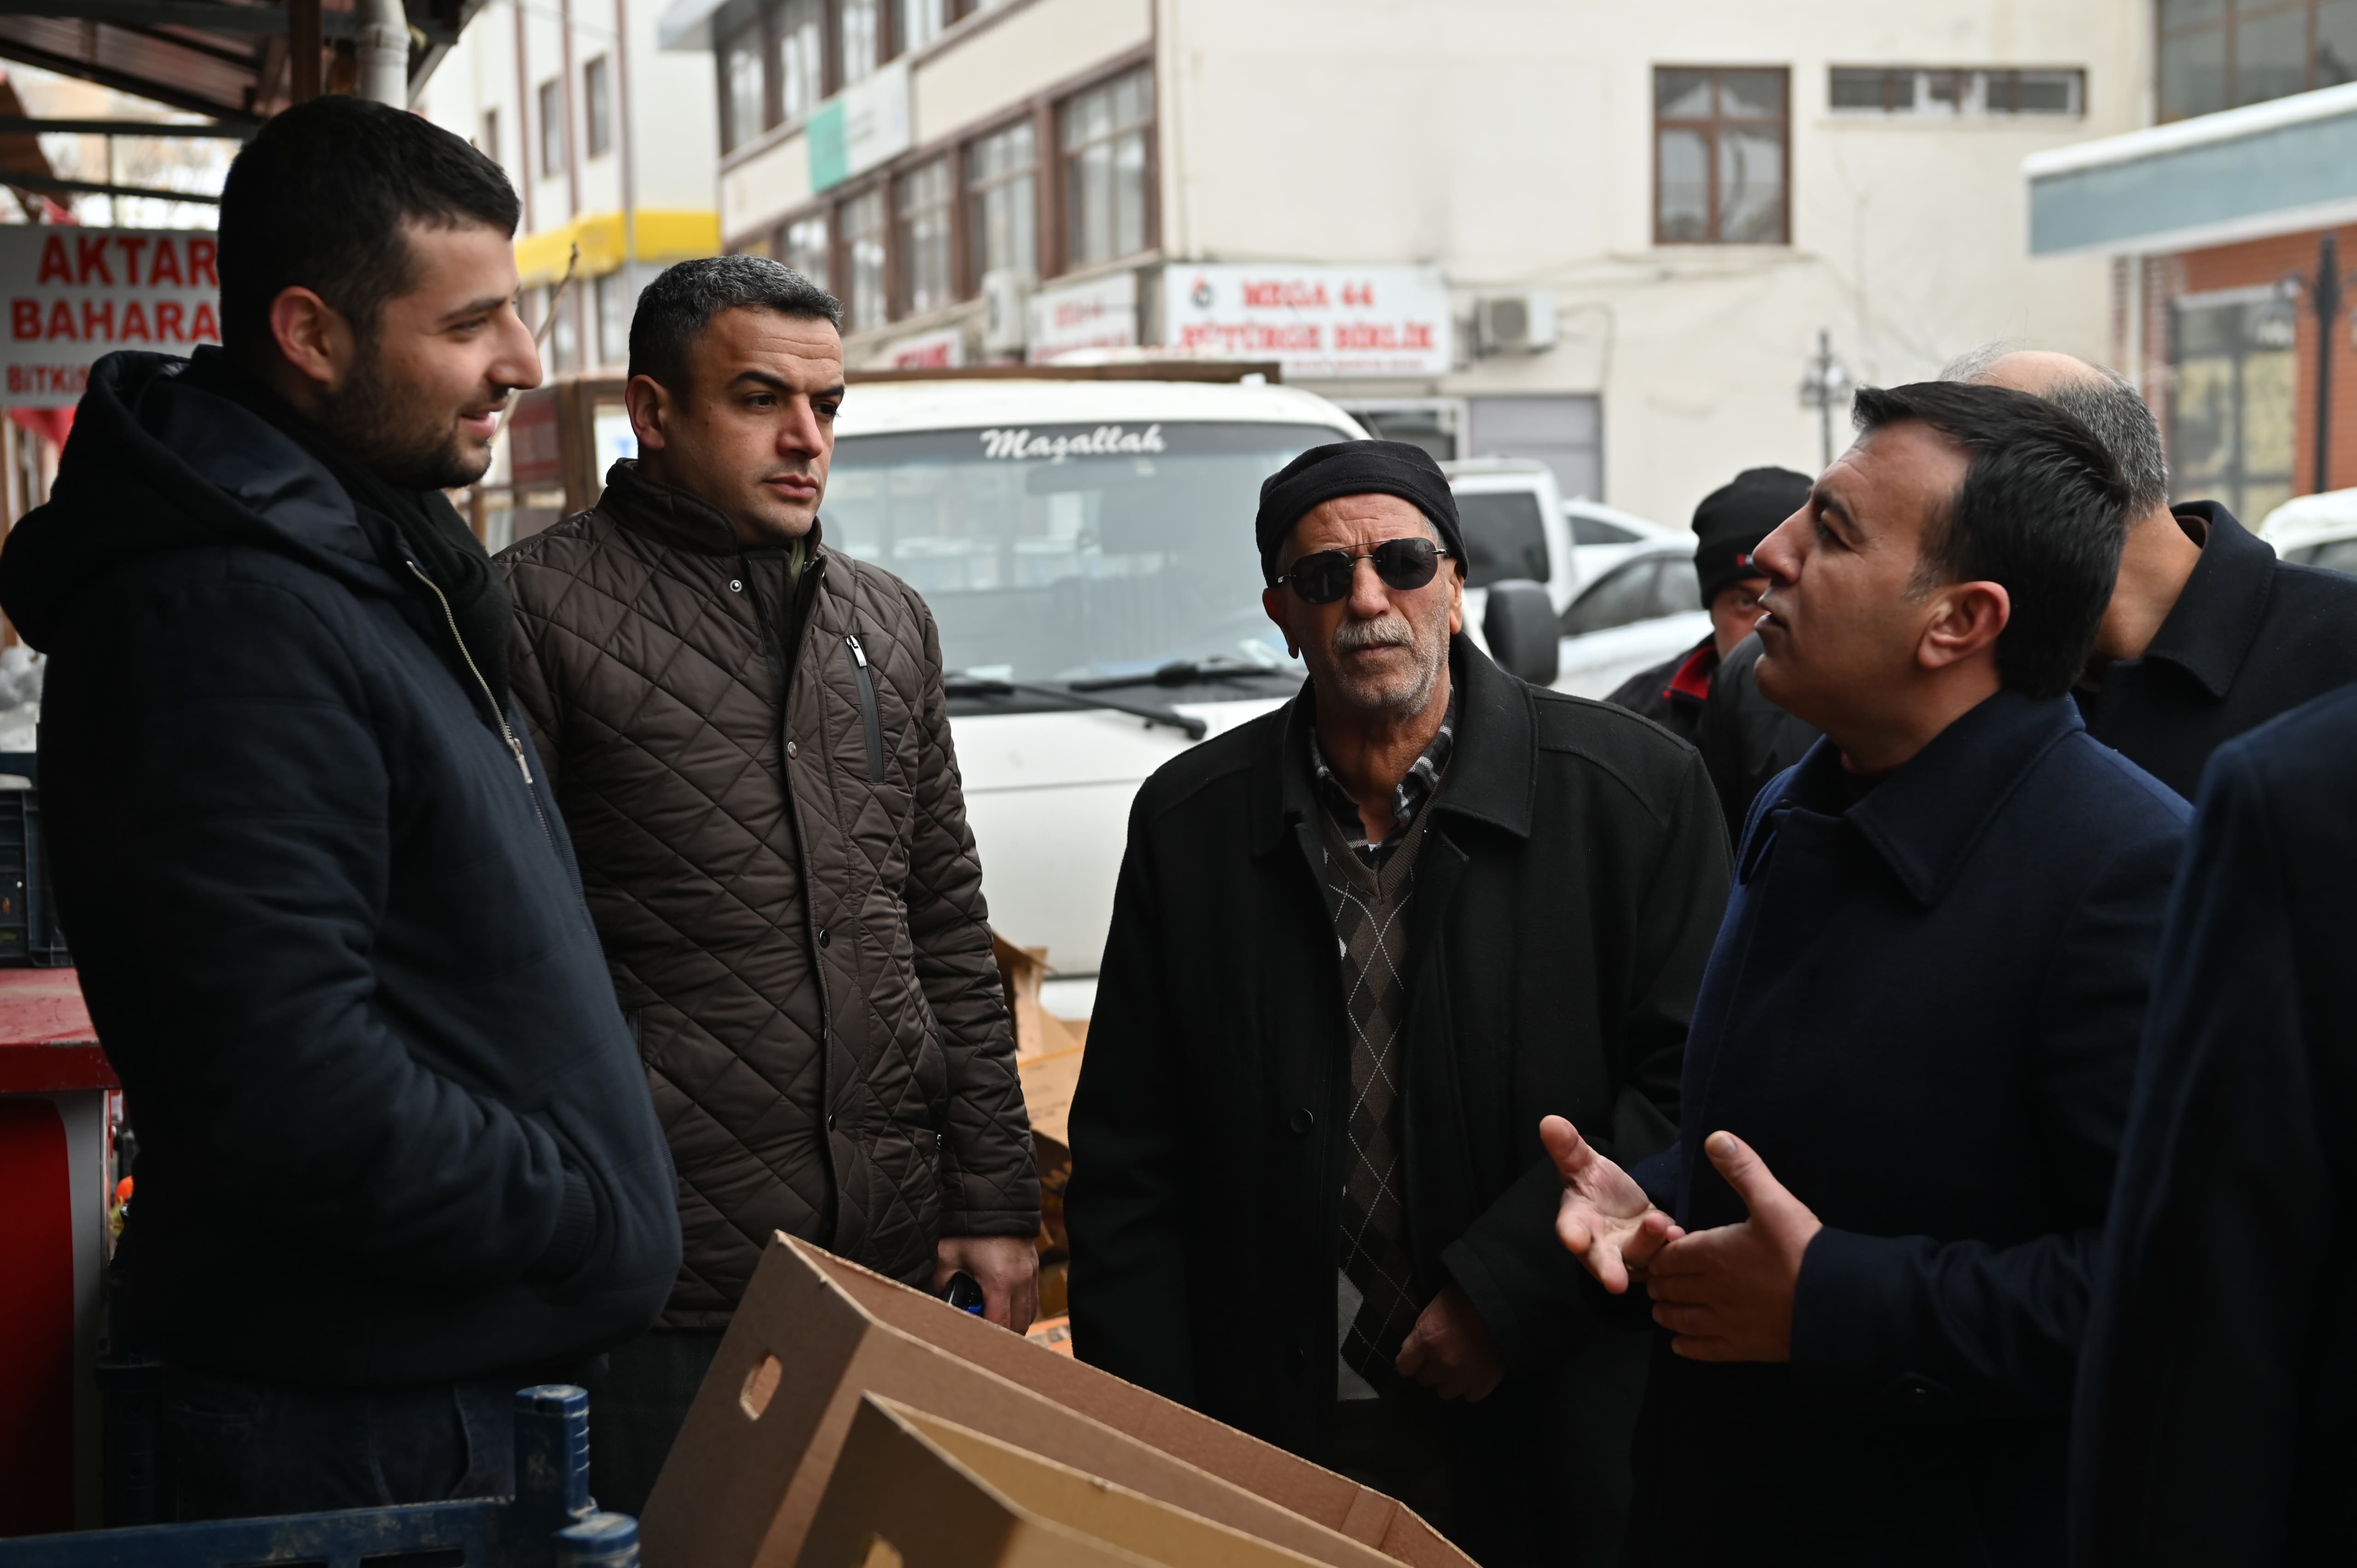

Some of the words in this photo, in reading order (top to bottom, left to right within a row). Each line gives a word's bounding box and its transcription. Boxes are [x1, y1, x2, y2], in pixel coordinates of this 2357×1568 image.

[37, 234, 219, 287] AKTAR
[1242, 281, 1330, 307] MEGA
[1341, 281, 1374, 307] 44
[11, 300, 222, 342] BAHARA
[979, 423, 1167, 465] Maşallah
